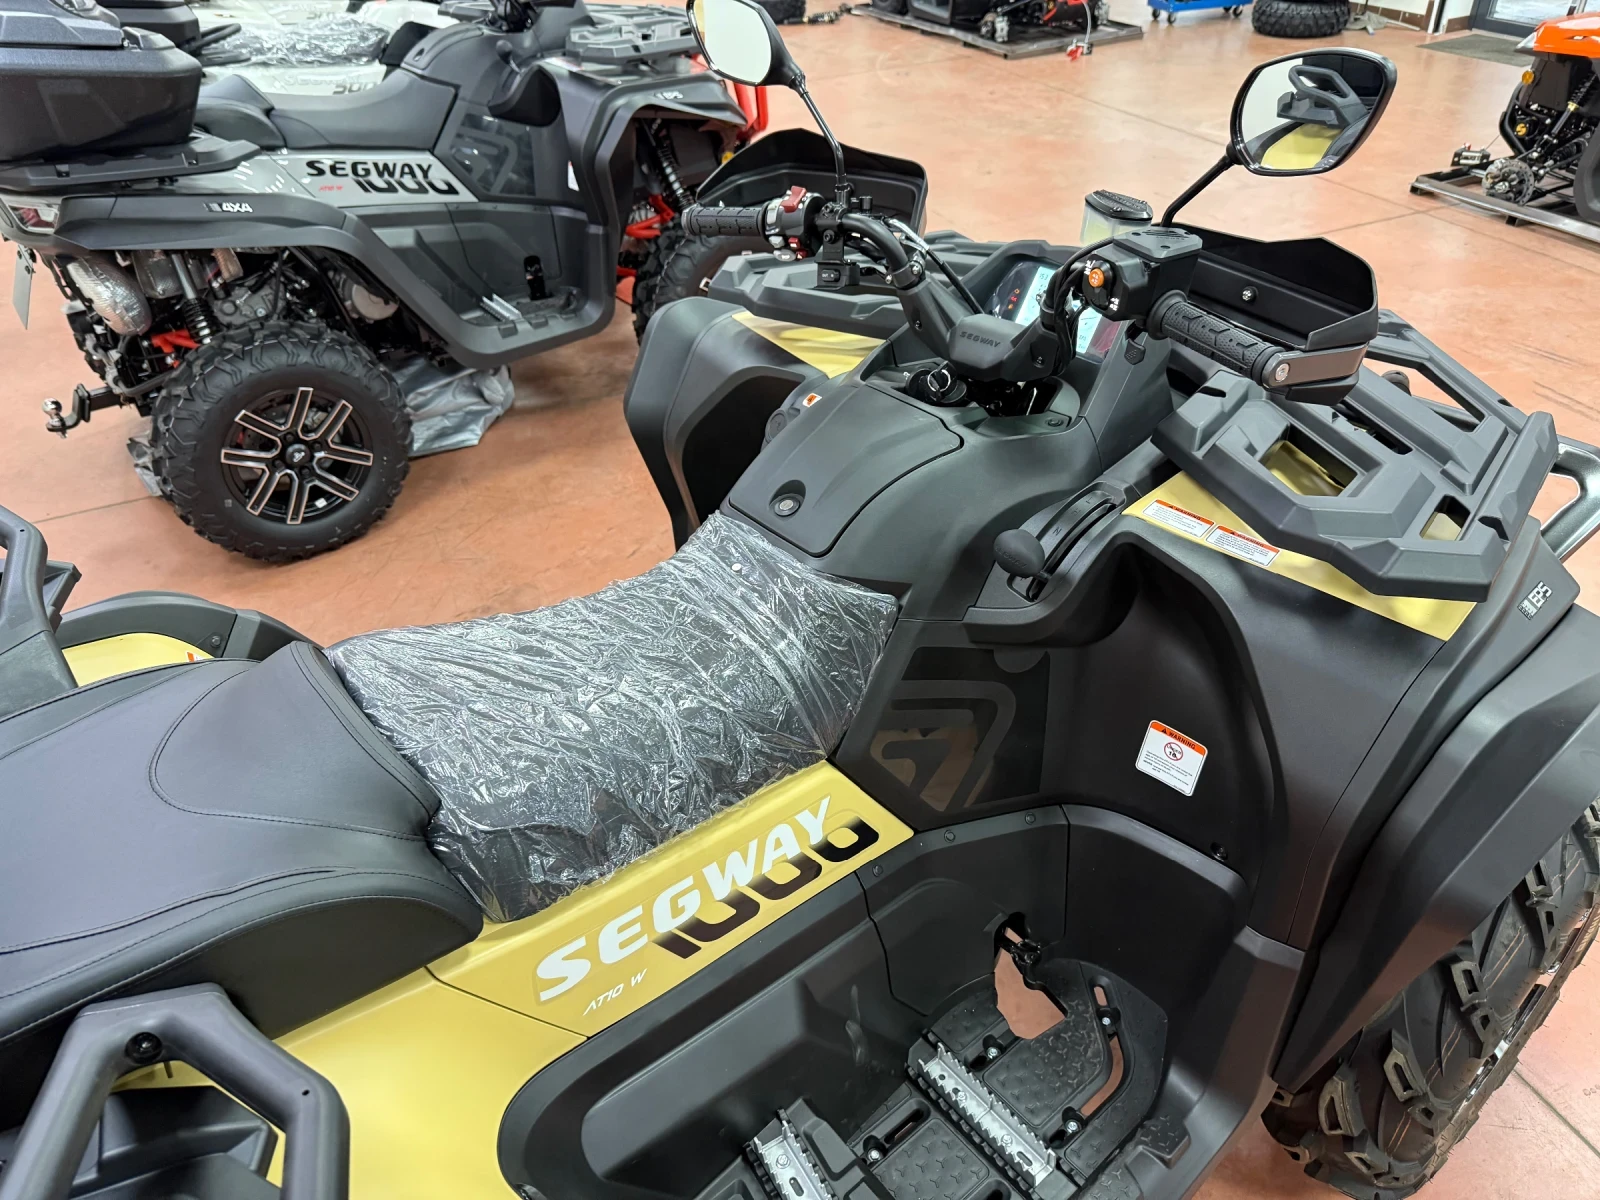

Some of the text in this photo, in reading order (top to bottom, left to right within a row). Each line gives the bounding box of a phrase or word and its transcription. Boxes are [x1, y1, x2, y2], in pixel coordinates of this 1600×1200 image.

[305, 160, 432, 179] SEGWAY
[960, 331, 1001, 348] SEGWAY
[1169, 731, 1196, 749] WARNING
[536, 796, 831, 1002] SEGWAY
[583, 968, 648, 1016] AT10 W
